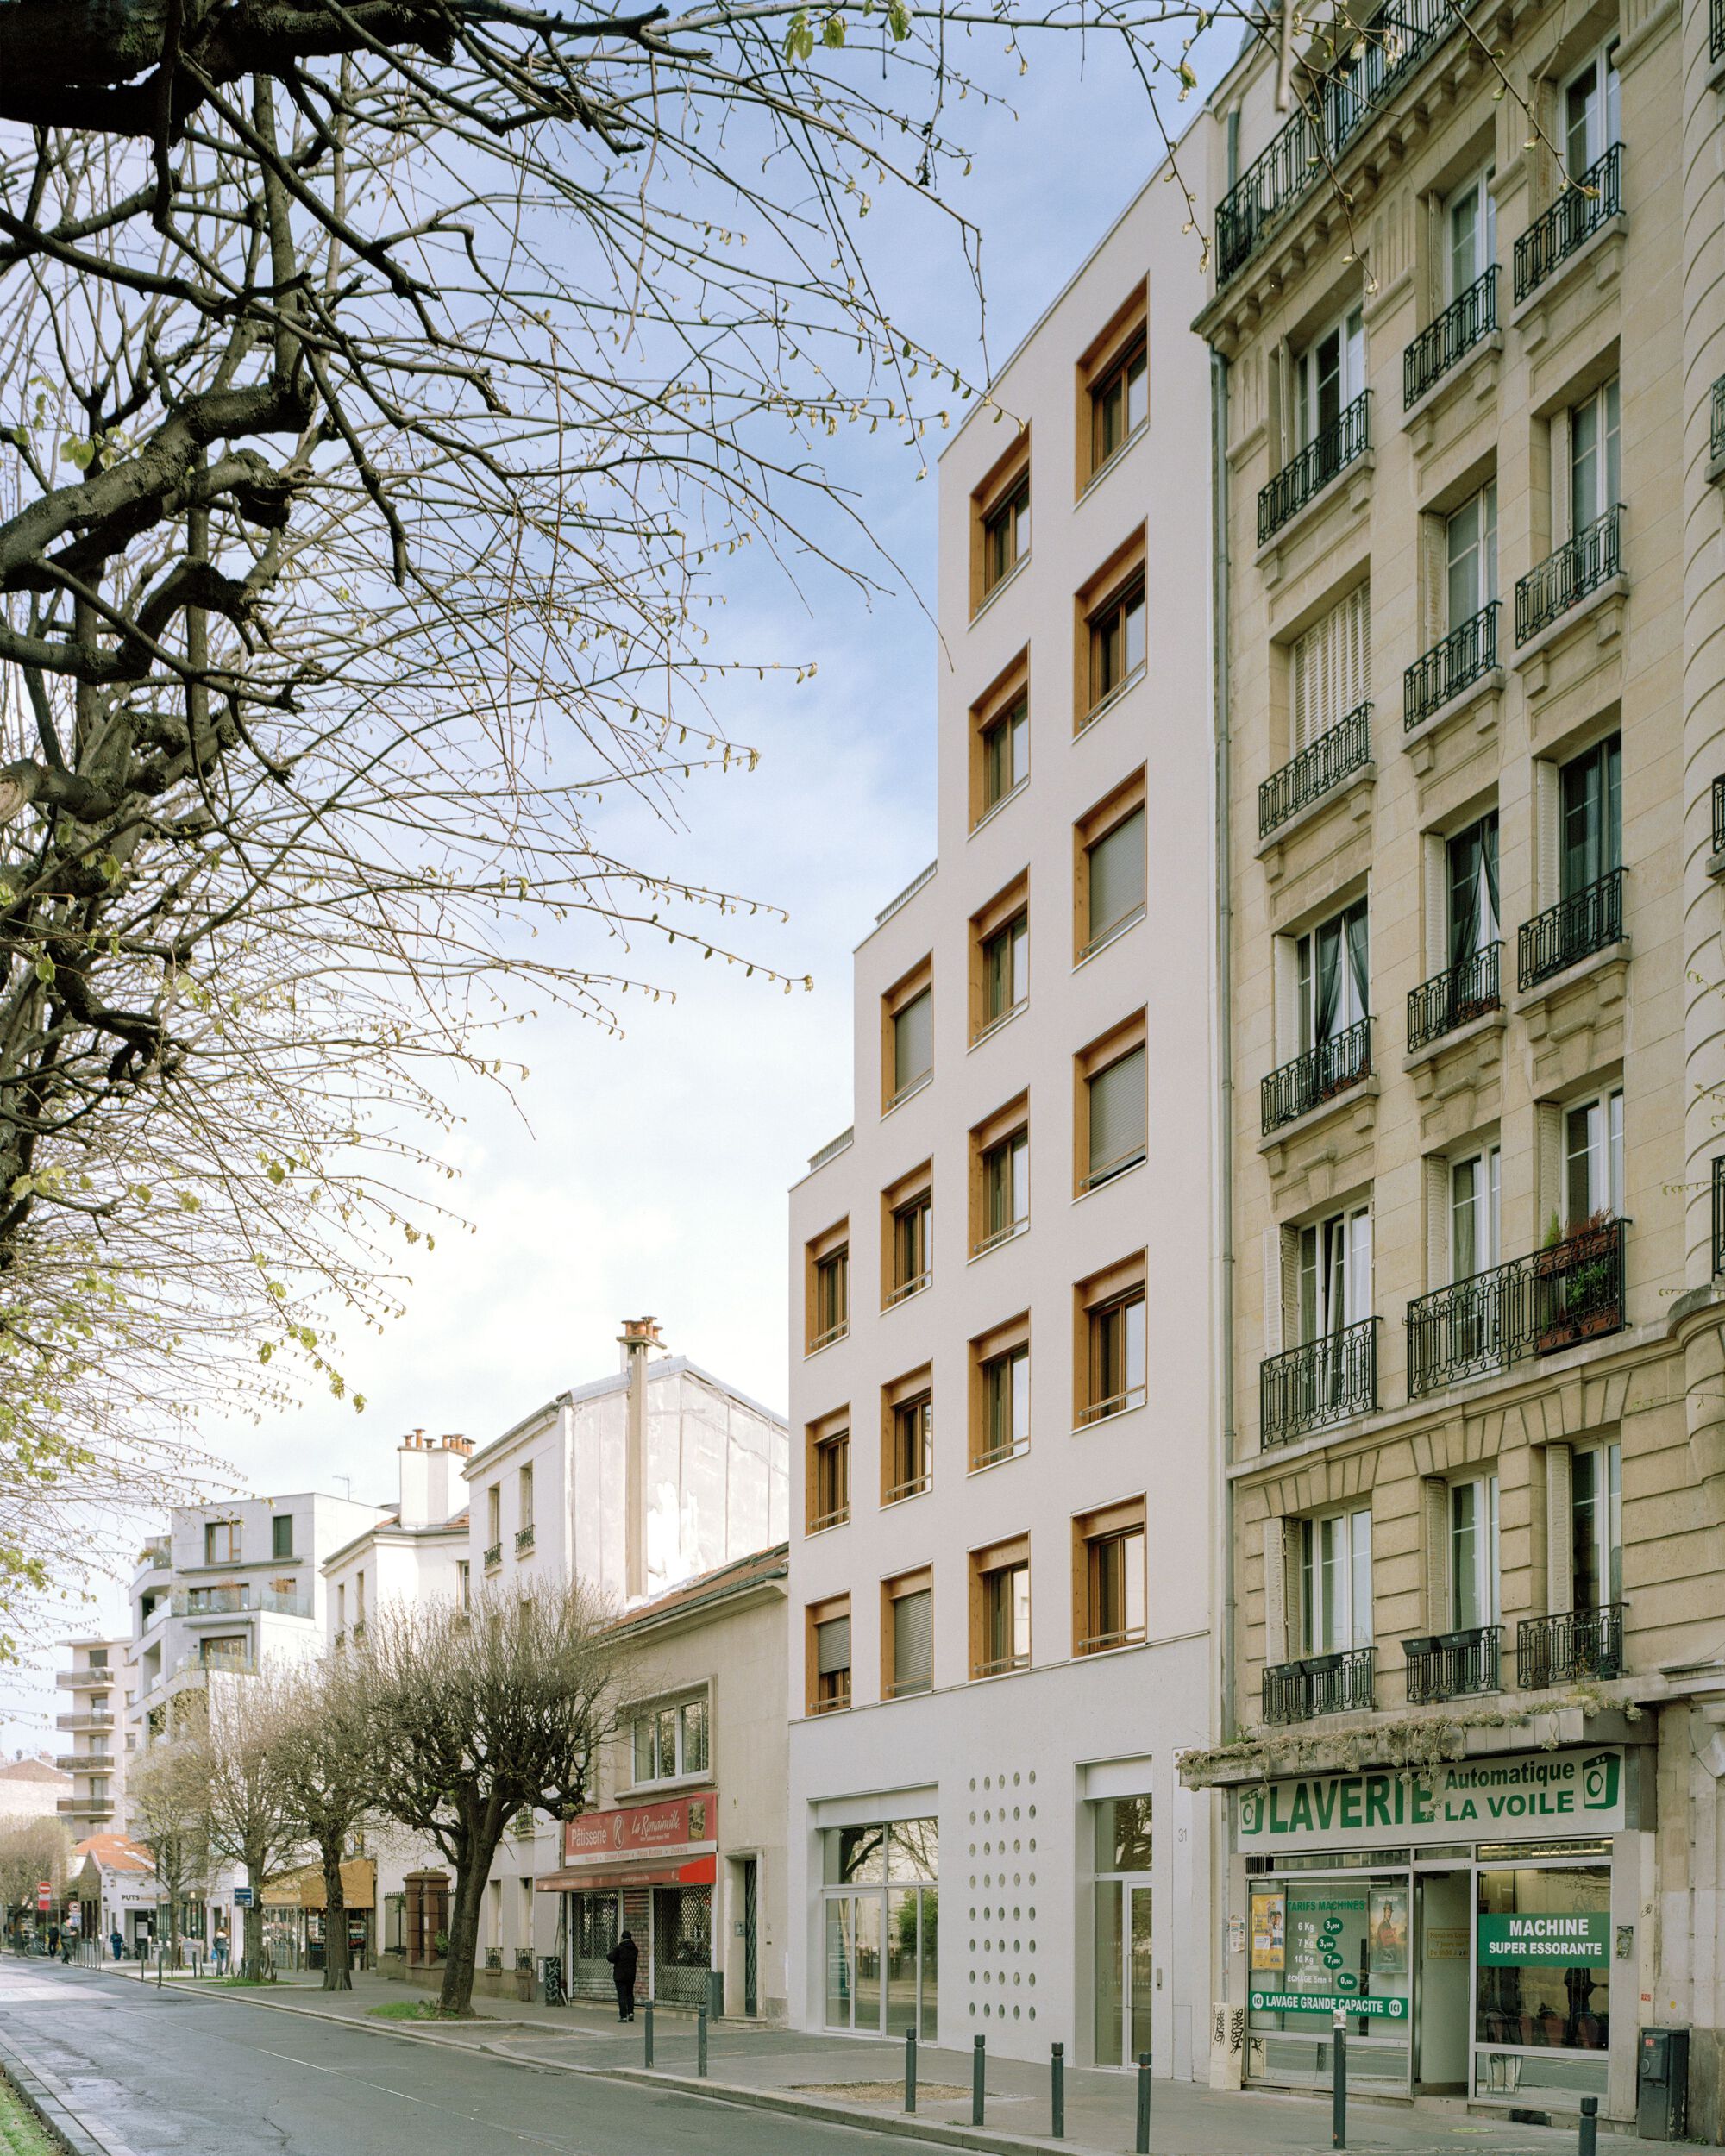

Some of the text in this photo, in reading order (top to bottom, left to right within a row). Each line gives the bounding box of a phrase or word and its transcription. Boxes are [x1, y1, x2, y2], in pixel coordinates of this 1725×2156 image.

[1445, 1761, 1575, 1791] Automatique
[1270, 1772, 1435, 1833] LAVERIE
[1445, 1790, 1575, 1821] LA VOILE
[571, 1826, 607, 1847] Pâtisserie
[1178, 1828, 1187, 1842] 31
[1287, 1900, 1366, 1911] TARIFS MACHINES
[1297, 1922, 1302, 1931] 6
[1304, 1922, 1314, 1933] Kg
[1509, 1919, 1589, 1937] MACHINE
[1297, 1938, 1302, 1947] 7
[1489, 1942, 1602, 1955] SUPER ESSORANTE
[1295, 1955, 1302, 1964] 18
[1304, 1955, 1314, 1965] Kg
[1253, 1996, 1401, 2014] ICI LAVAGE GRANDE CAPACITE ICI
